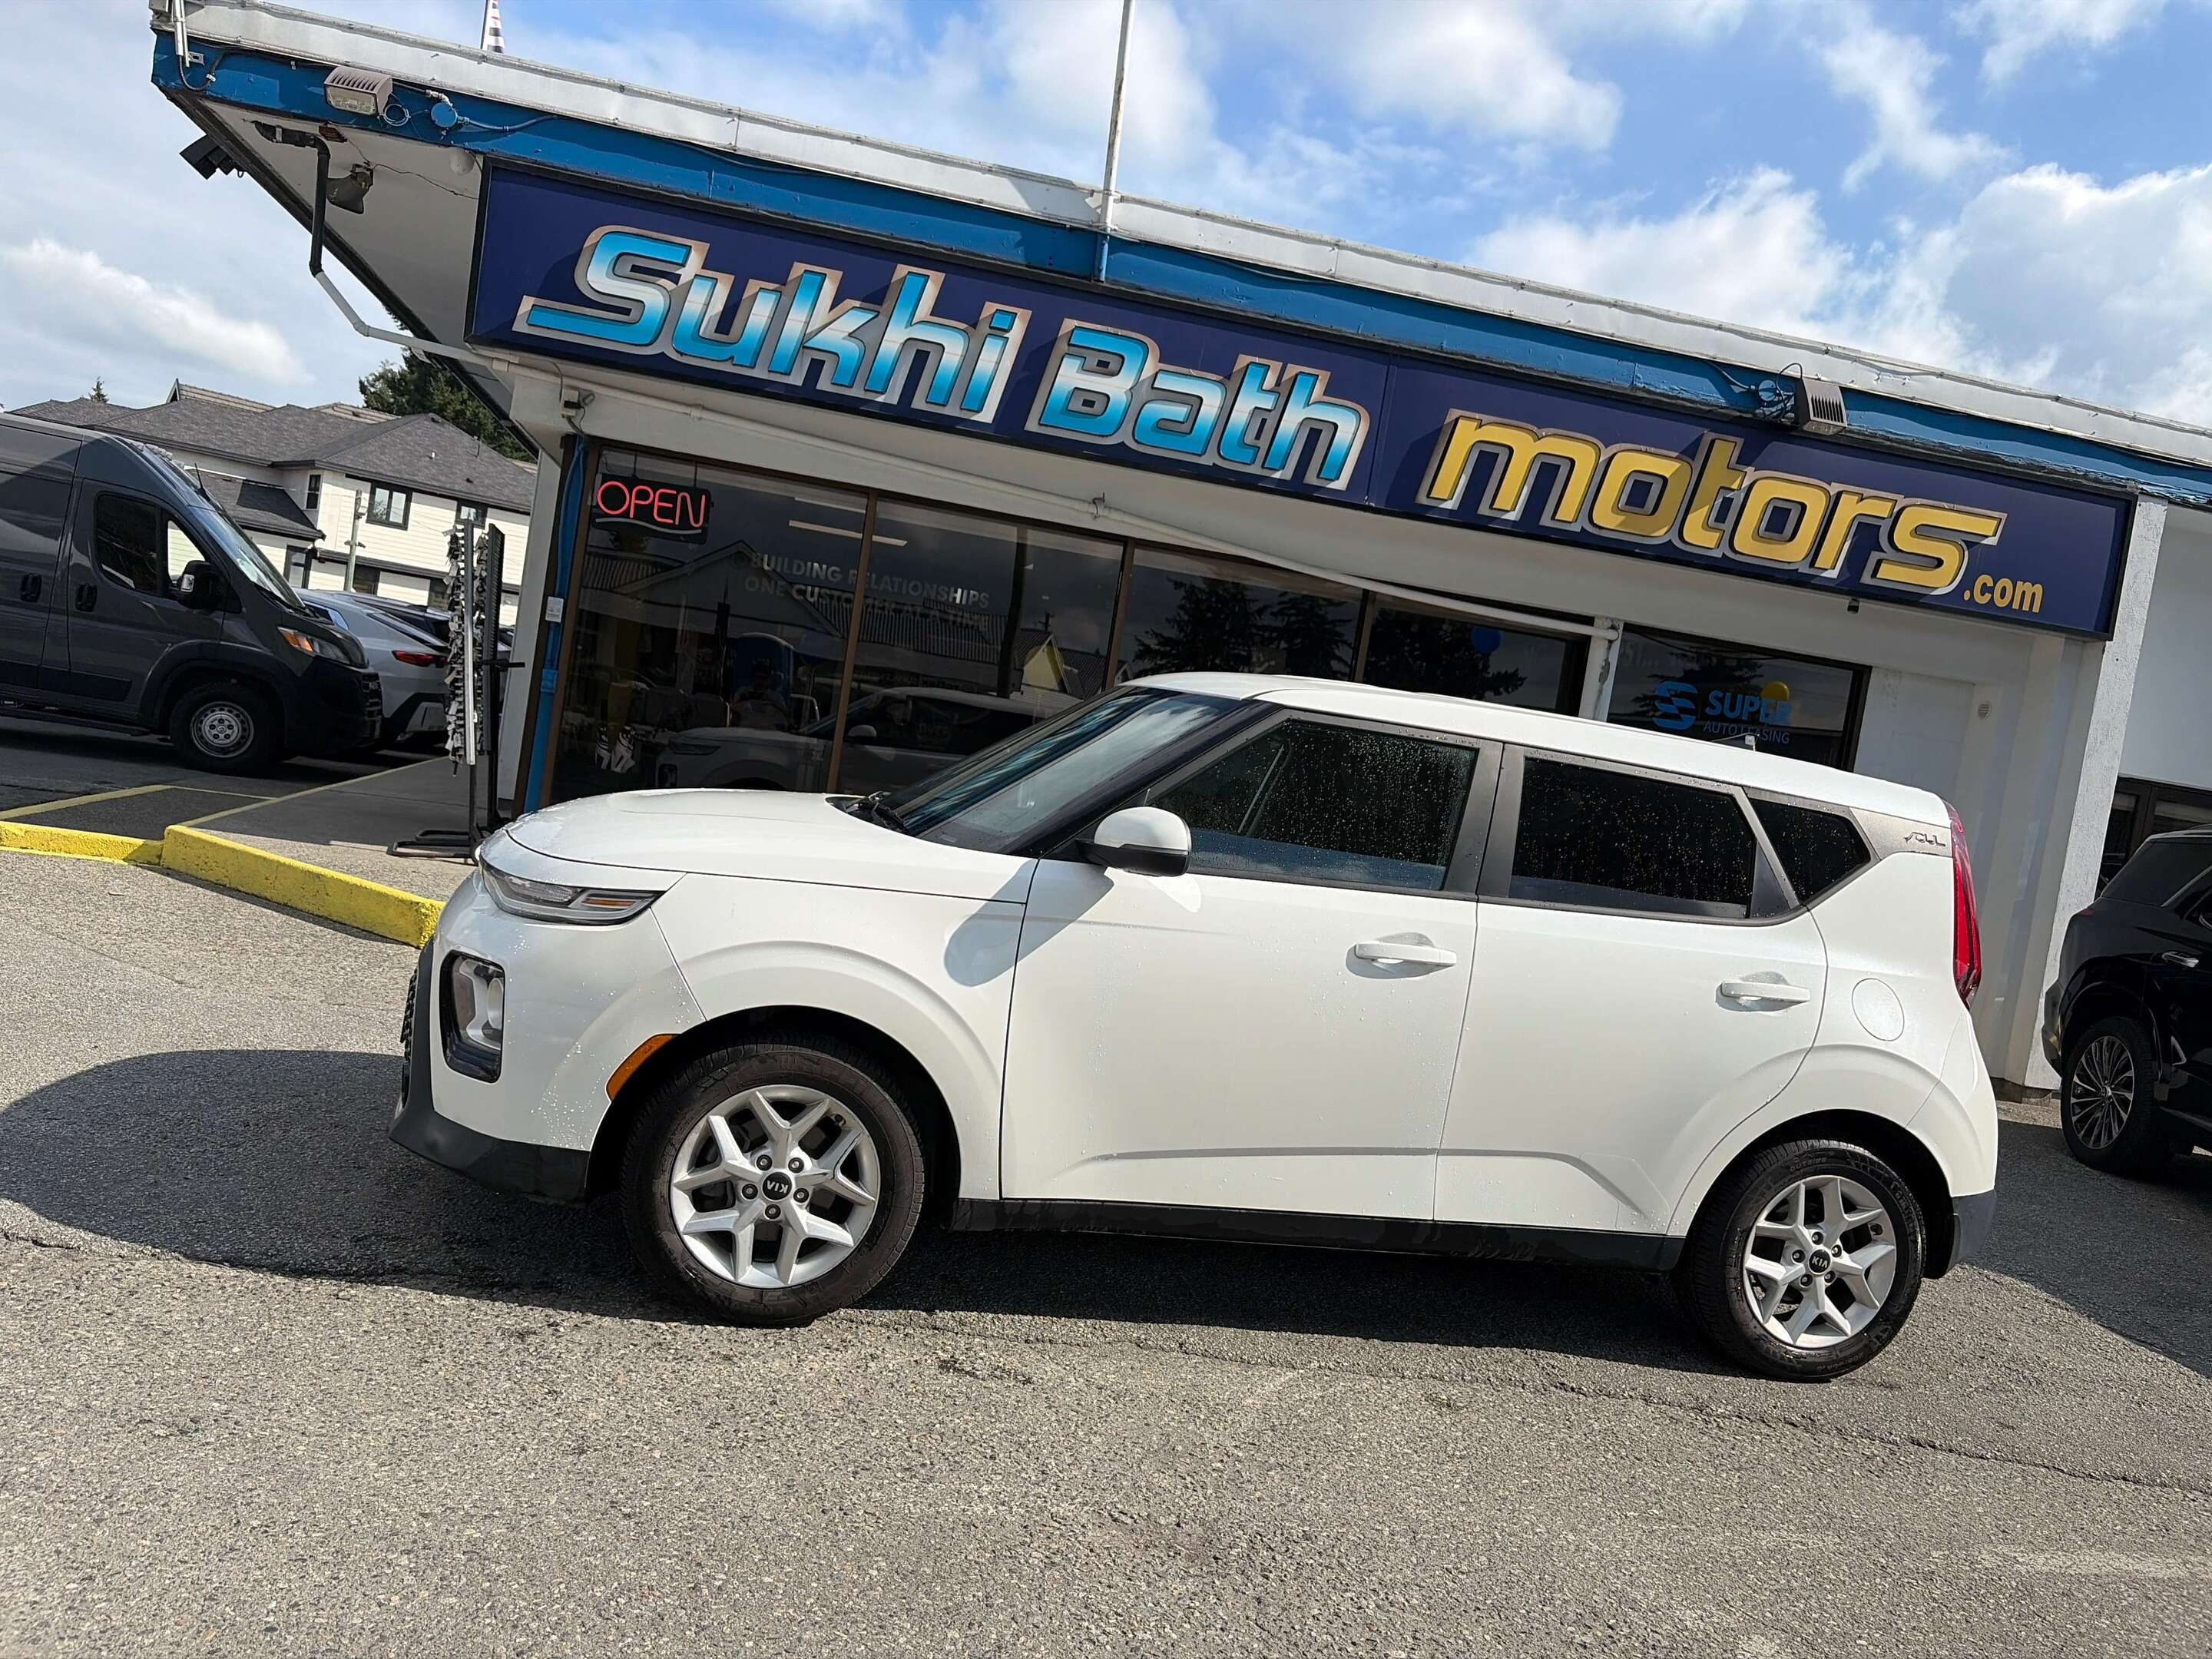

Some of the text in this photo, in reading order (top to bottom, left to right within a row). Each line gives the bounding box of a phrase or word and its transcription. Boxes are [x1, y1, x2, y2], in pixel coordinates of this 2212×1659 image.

[513, 225, 2044, 613] Sukhi Bath motors .com
[596, 481, 706, 528] OPEN
[745, 576, 786, 597] ONE
[753, 552, 990, 609] BUILDING RLATIONSHIPS
[1705, 689, 1793, 724] SUPER
[1703, 720, 1737, 735] AUTO
[767, 1180, 789, 1194] KIA
[1812, 1256, 1828, 1269] KIA
